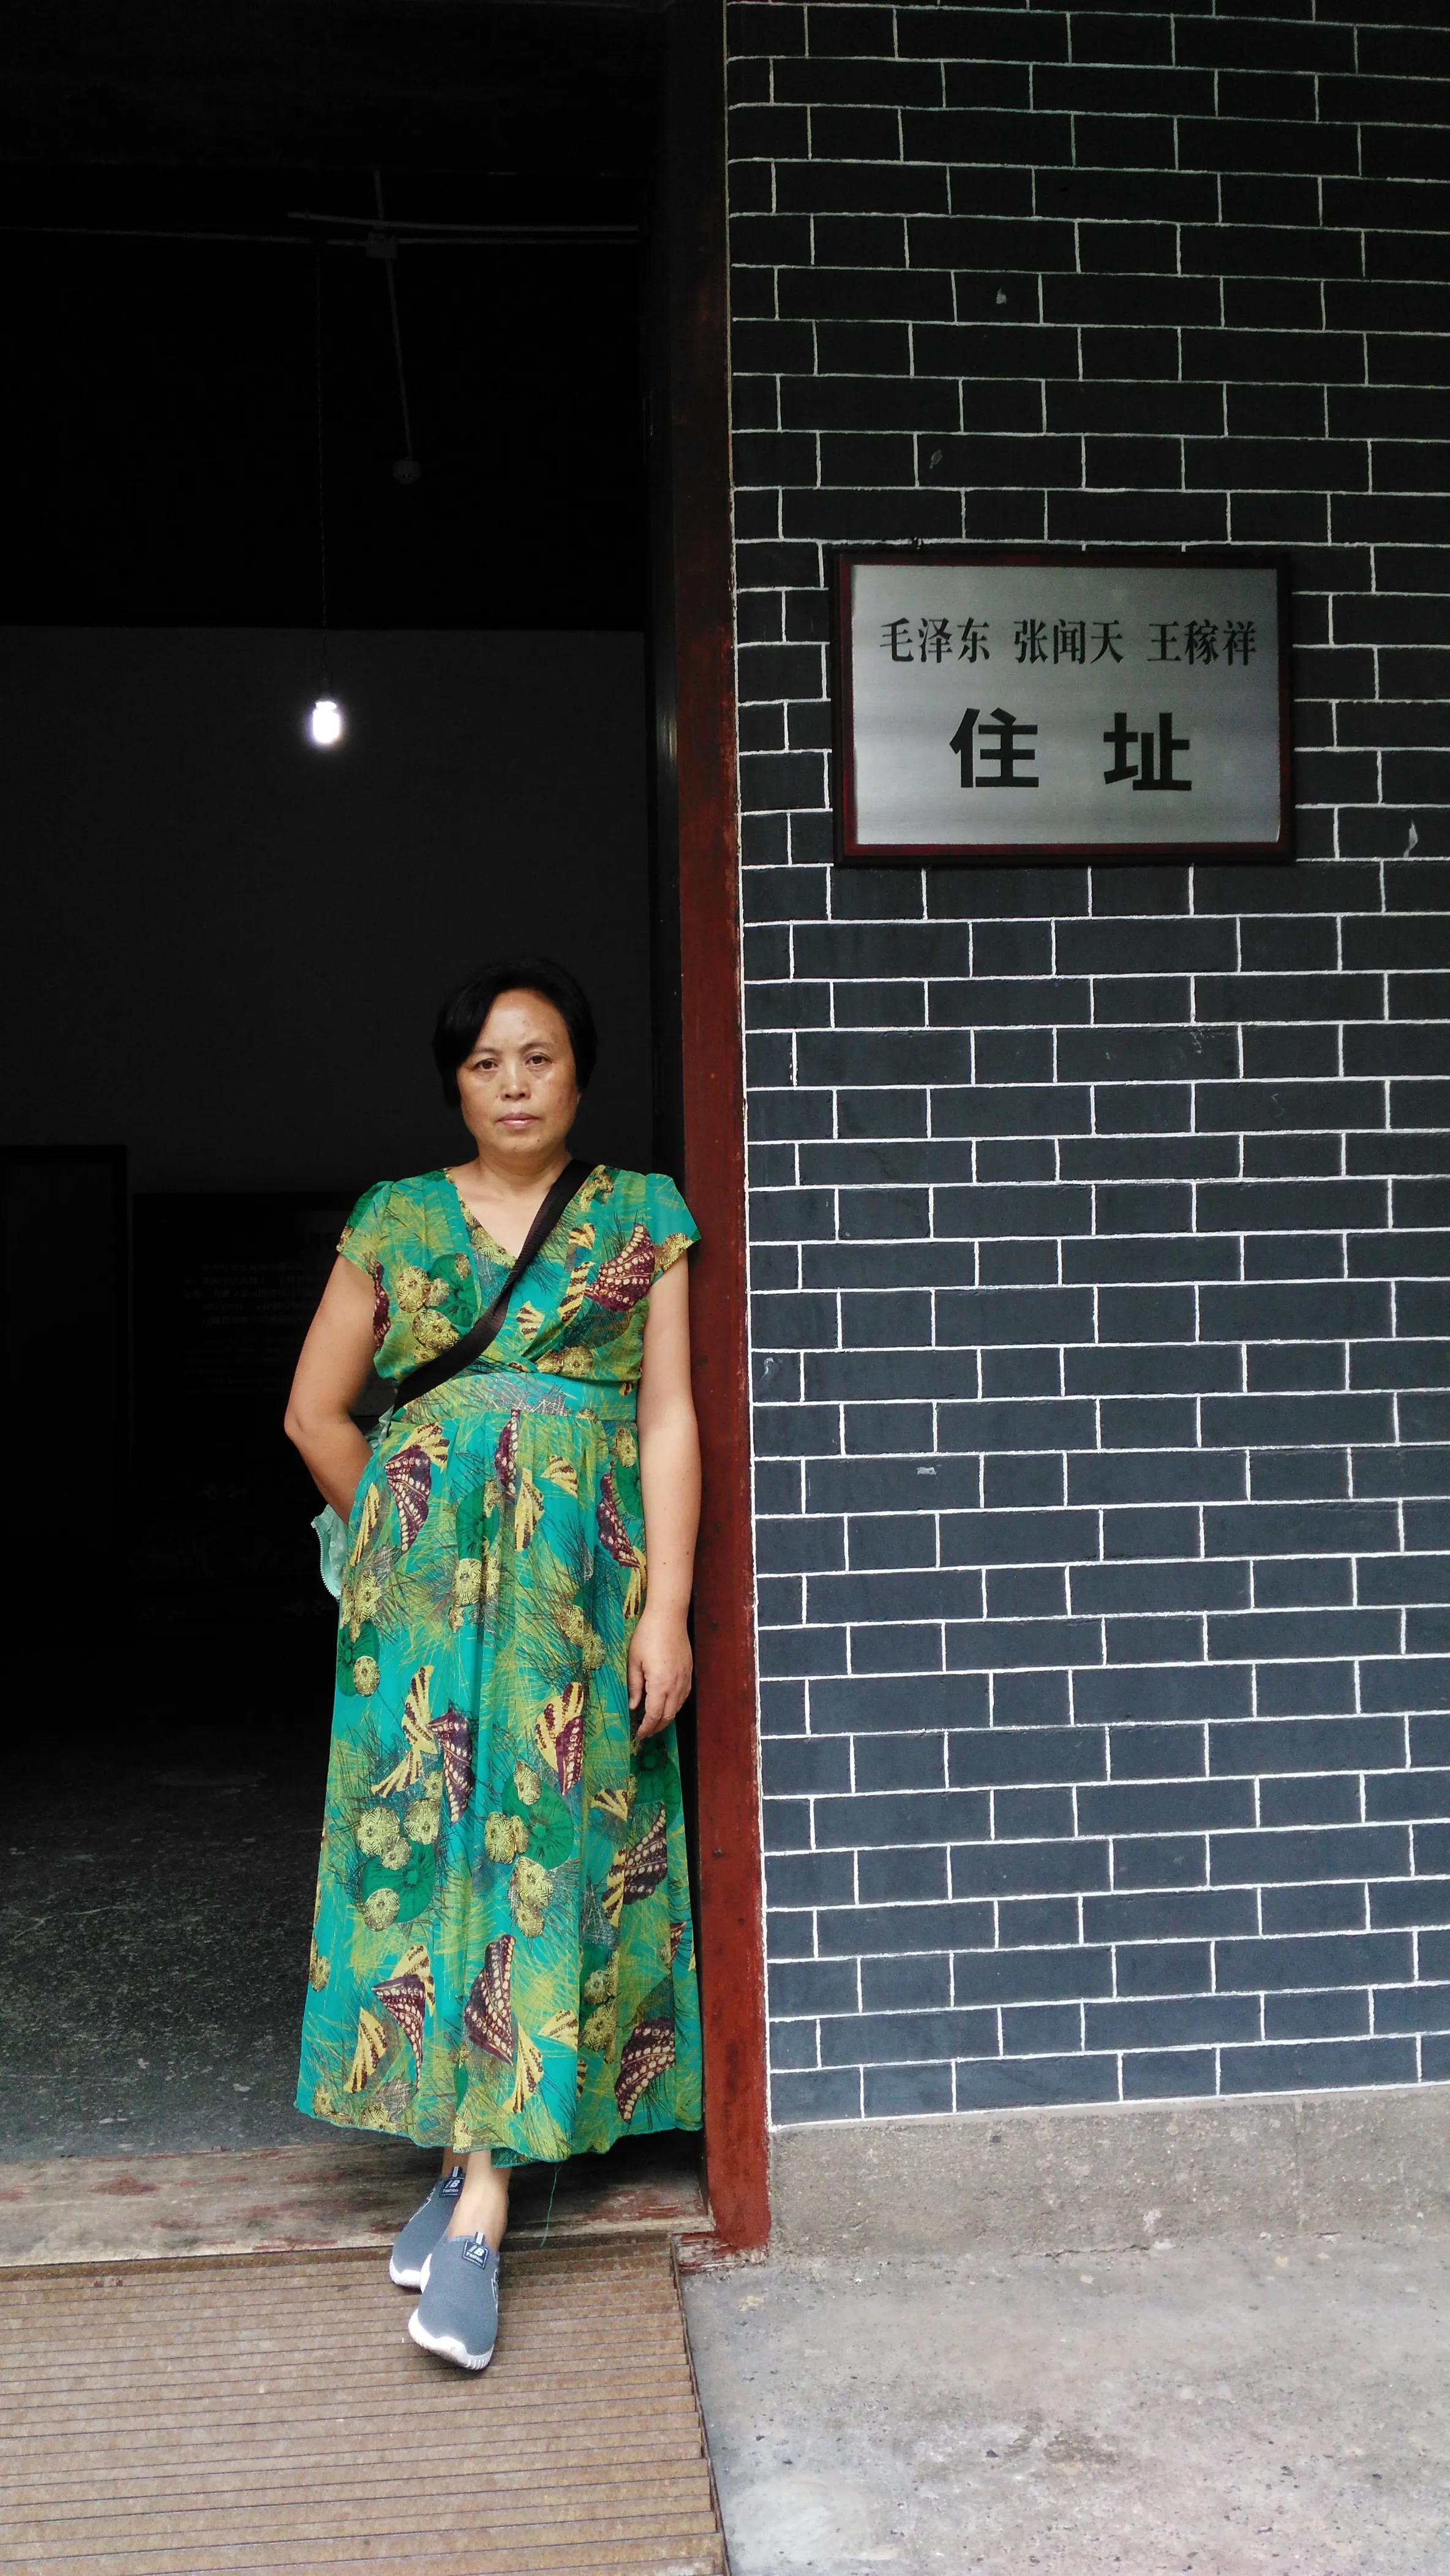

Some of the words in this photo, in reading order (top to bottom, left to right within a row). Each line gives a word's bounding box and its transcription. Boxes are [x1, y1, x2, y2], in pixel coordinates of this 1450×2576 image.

[880, 618, 990, 664] 毛泽东
[1014, 618, 1124, 665] 张闻天
[1148, 620, 1257, 666] 王稼祥
